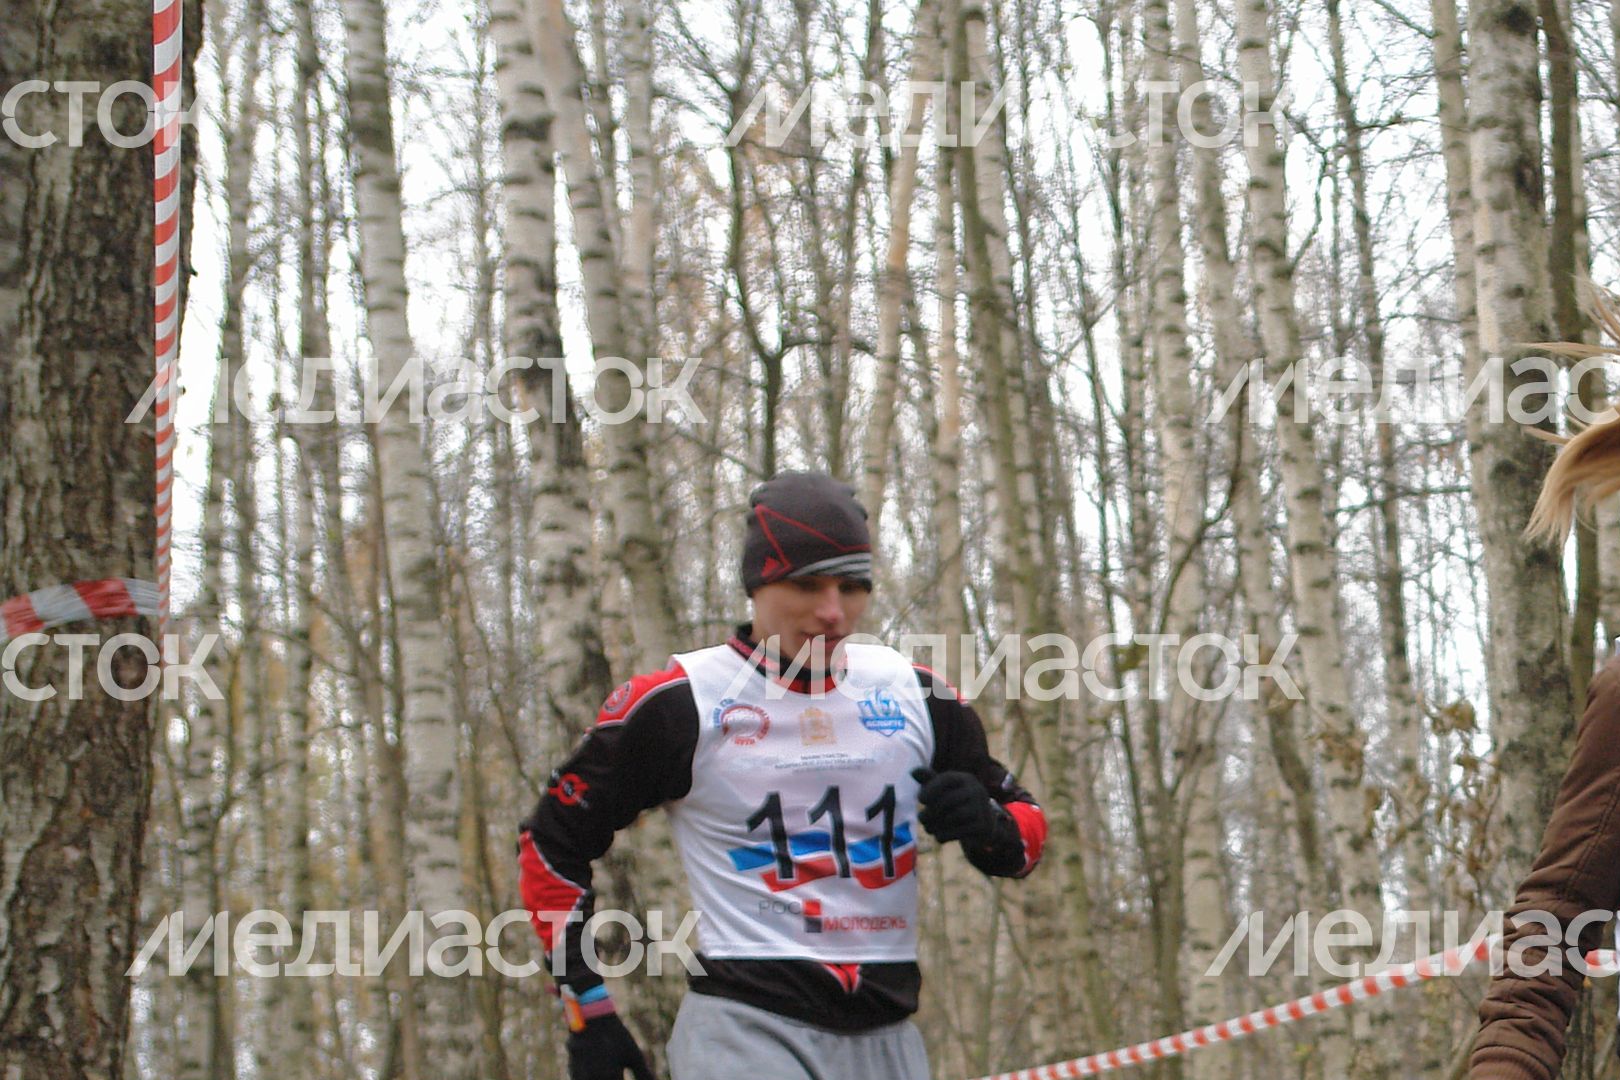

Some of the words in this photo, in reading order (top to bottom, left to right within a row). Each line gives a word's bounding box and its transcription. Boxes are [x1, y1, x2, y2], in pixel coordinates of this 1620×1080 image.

[745, 783, 896, 881] 111
[758, 900, 802, 916] РОС
[823, 915, 907, 932] МОЛОДЕЖЬ
